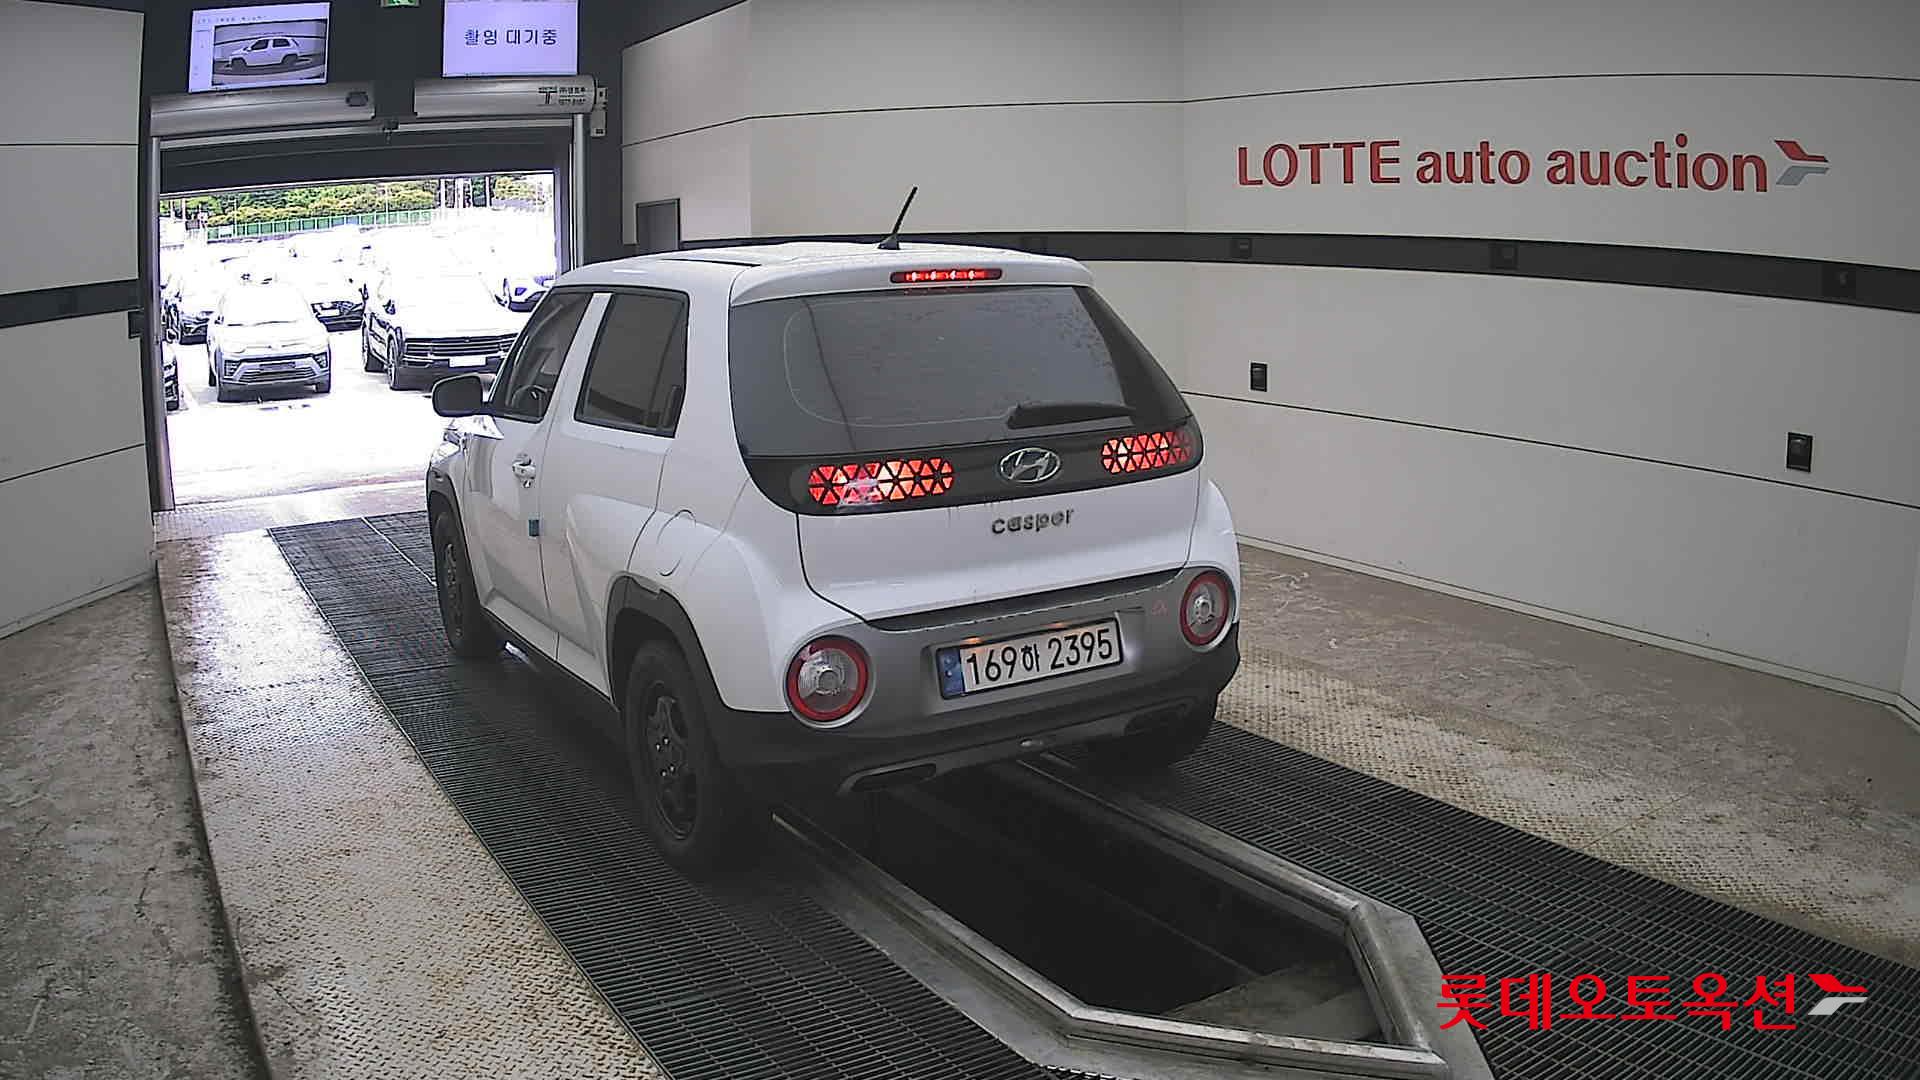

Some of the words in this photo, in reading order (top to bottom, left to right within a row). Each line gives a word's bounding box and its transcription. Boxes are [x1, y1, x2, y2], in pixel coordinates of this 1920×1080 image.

[506, 28, 558, 46] 대기중
[1238, 140, 1400, 187] LOTTE
[1416, 141, 1531, 185] auto
[1546, 133, 1768, 192] auction
[991, 508, 1075, 535] casper
[966, 643, 1041, 685] 169하
[1047, 628, 1113, 671] 2395
